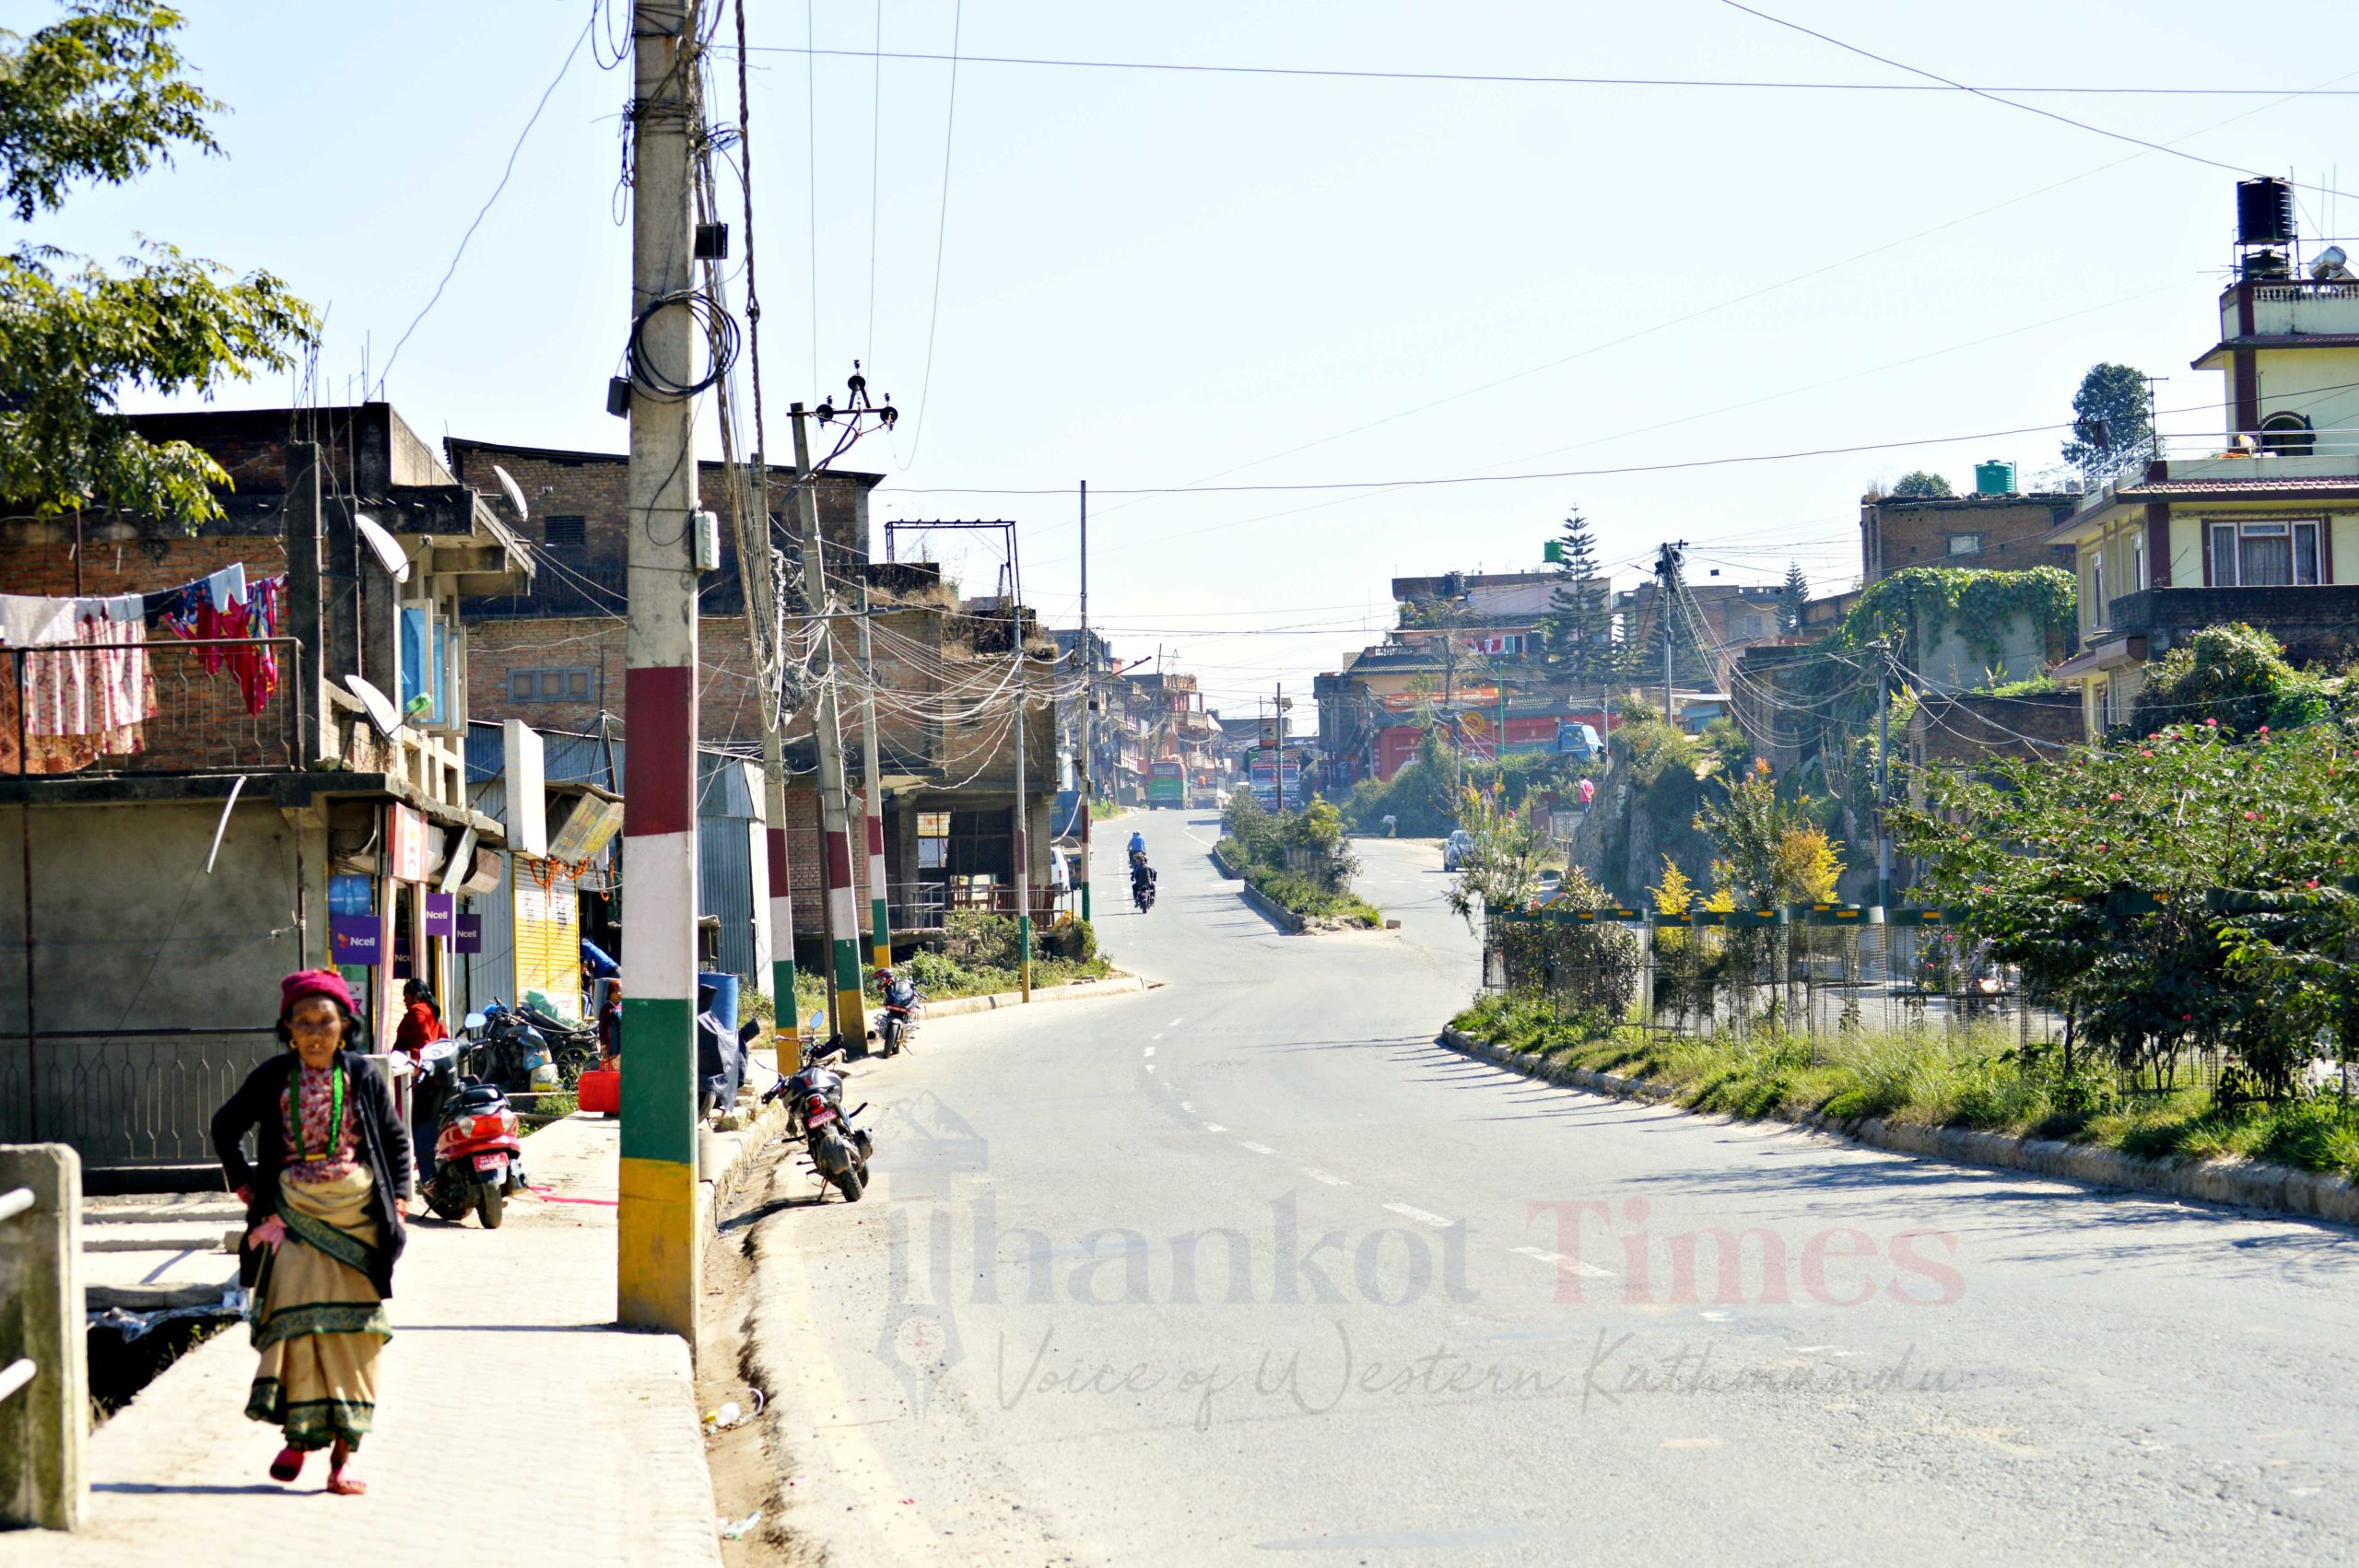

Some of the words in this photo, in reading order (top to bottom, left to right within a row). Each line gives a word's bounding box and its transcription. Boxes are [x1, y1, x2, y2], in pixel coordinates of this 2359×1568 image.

[426, 910, 448, 919] Ncell
[456, 930, 477, 938] Ncell
[350, 936, 376, 946] Ncell
[394, 954, 412, 962] Nce
